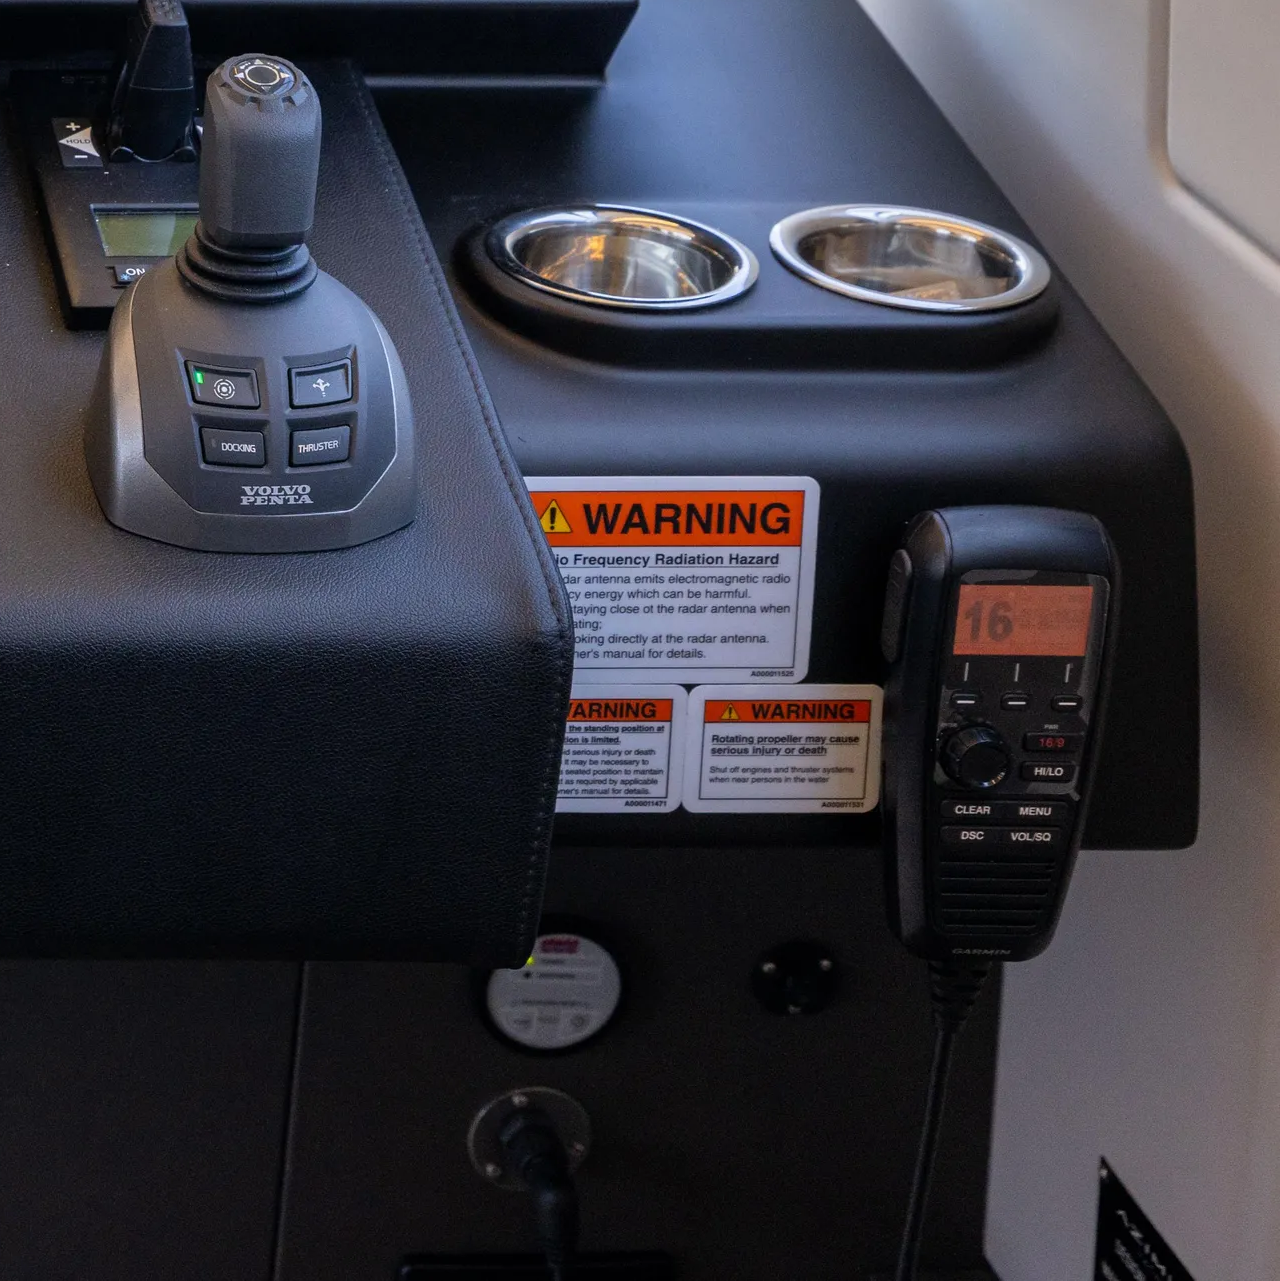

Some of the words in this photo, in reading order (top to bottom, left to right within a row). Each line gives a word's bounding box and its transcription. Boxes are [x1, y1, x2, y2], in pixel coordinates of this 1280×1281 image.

[221, 442, 256, 453] DOCKING
[298, 440, 339, 453] THRUSTER
[242, 485, 311, 496] VOLVO
[240, 495, 314, 506] PENTA
[583, 502, 791, 535] WARNING
[574, 553, 650, 568] Frequency
[655, 553, 724, 565] Radiation
[729, 553, 779, 565] Hazard
[584, 575, 631, 584] antenna
[634, 574, 665, 584] emits
[668, 574, 759, 586] electromagnetic
[762, 574, 791, 584] radio
[584, 591, 624, 601] energy
[627, 589, 660, 599] which
[663, 590, 684, 599] can
[687, 589, 702, 599] be
[705, 588, 752, 599] harmful.
[610, 604, 640, 614] close
[643, 605, 654, 614] ot
[657, 604, 675, 614] the
[678, 604, 708, 614] radar
[710, 604, 756, 614] antenna
[760, 604, 791, 614] when
[965, 600, 1013, 642] 16
[608, 634, 648, 646] directly
[652, 635, 663, 644] at
[666, 634, 684, 644] the
[687, 634, 717, 644] radar
[720, 634, 769, 644] antenna.
[603, 649, 645, 659] manual
[648, 649, 663, 659] for
[666, 649, 706, 659] details.
[569, 702, 657, 718] ARNING
[751, 703, 855, 719] WARNING
[584, 725, 620, 733] standing
[621, 725, 654, 733] position
[711, 734, 754, 745] Rotating
[757, 734, 802, 745] propeller
[805, 736, 826, 745] may
[829, 736, 860, 744] cause
[1039, 738, 1065, 748] 16/9
[711, 746, 749, 755] serious
[752, 745, 781, 756] injury
[785, 746, 795, 755] or
[797, 745, 827, 754] death
[1034, 768, 1064, 776] HI/LO
[955, 805, 991, 814] CLEAR
[1019, 807, 1051, 816] MENU
[961, 832, 984, 840] DSC
[1011, 832, 1051, 842] VOL/SQ
